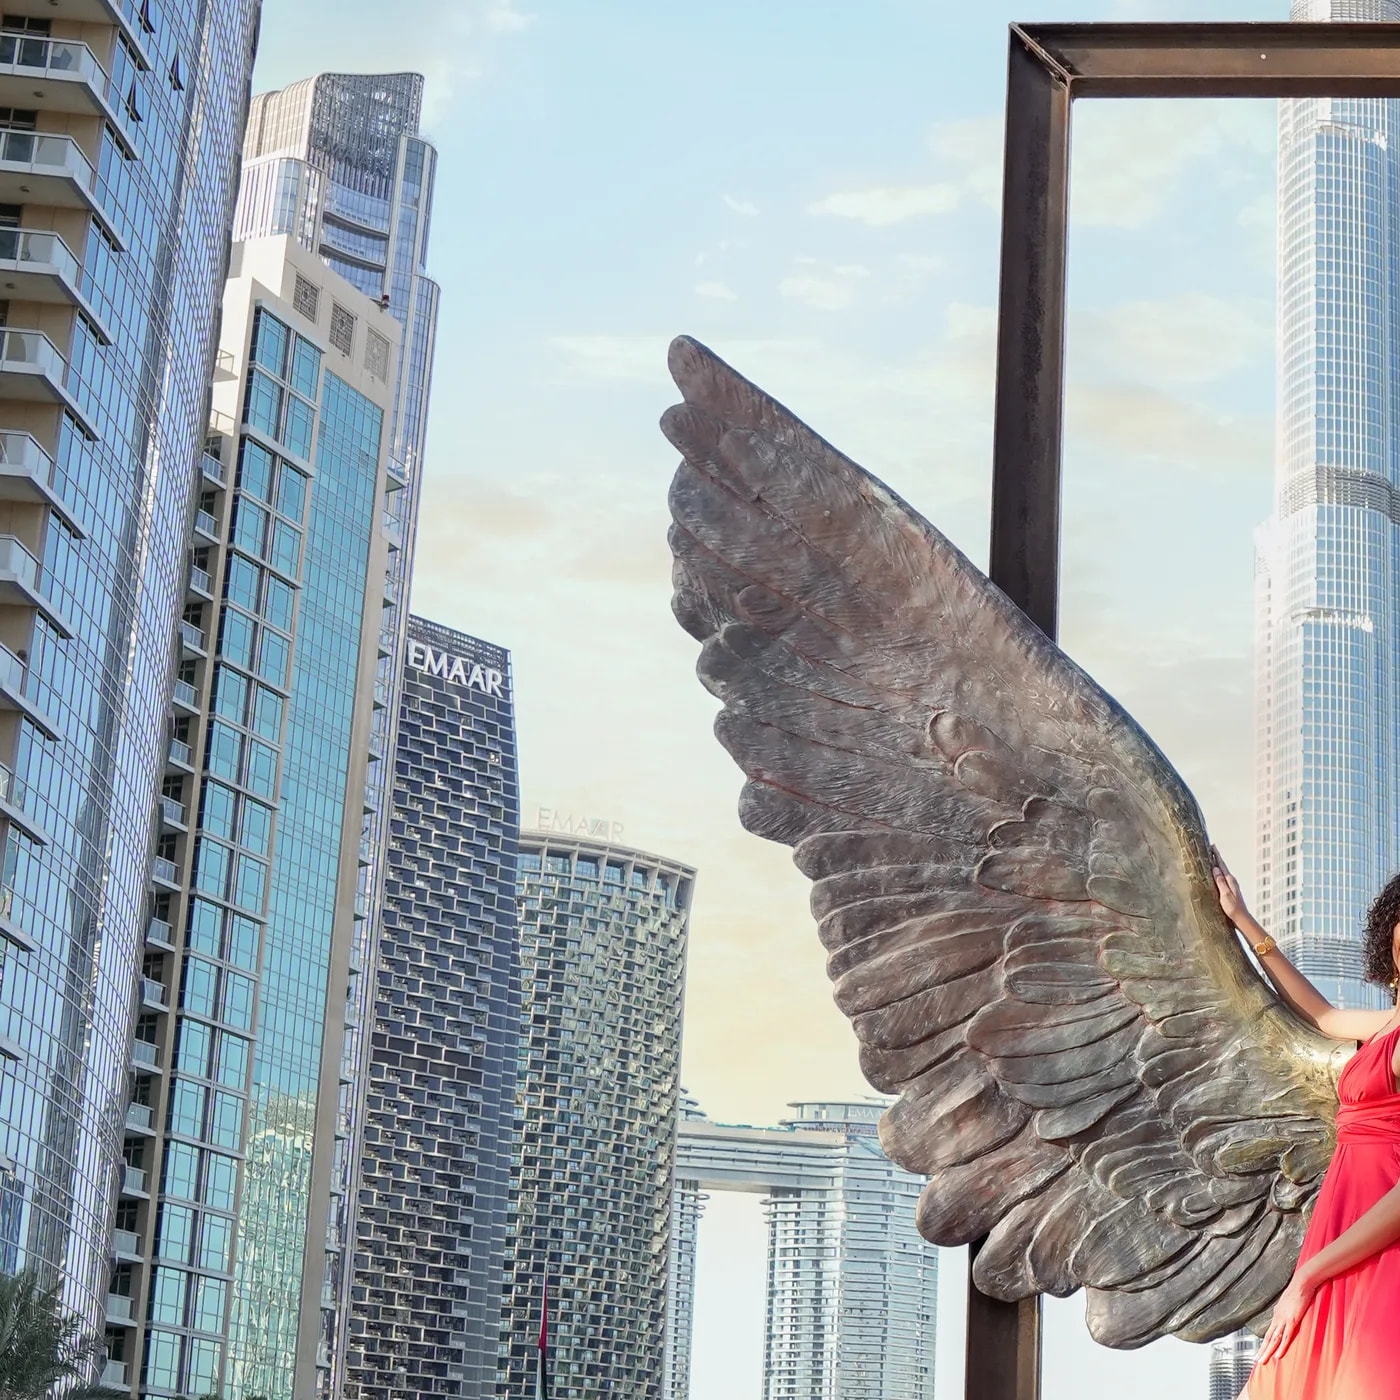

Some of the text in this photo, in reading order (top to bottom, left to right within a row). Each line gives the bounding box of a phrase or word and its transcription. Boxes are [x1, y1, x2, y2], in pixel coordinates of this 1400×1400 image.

[407, 639, 503, 698] EMAAR
[537, 805, 624, 842] EMAAR
[848, 1106, 881, 1119] EMA
